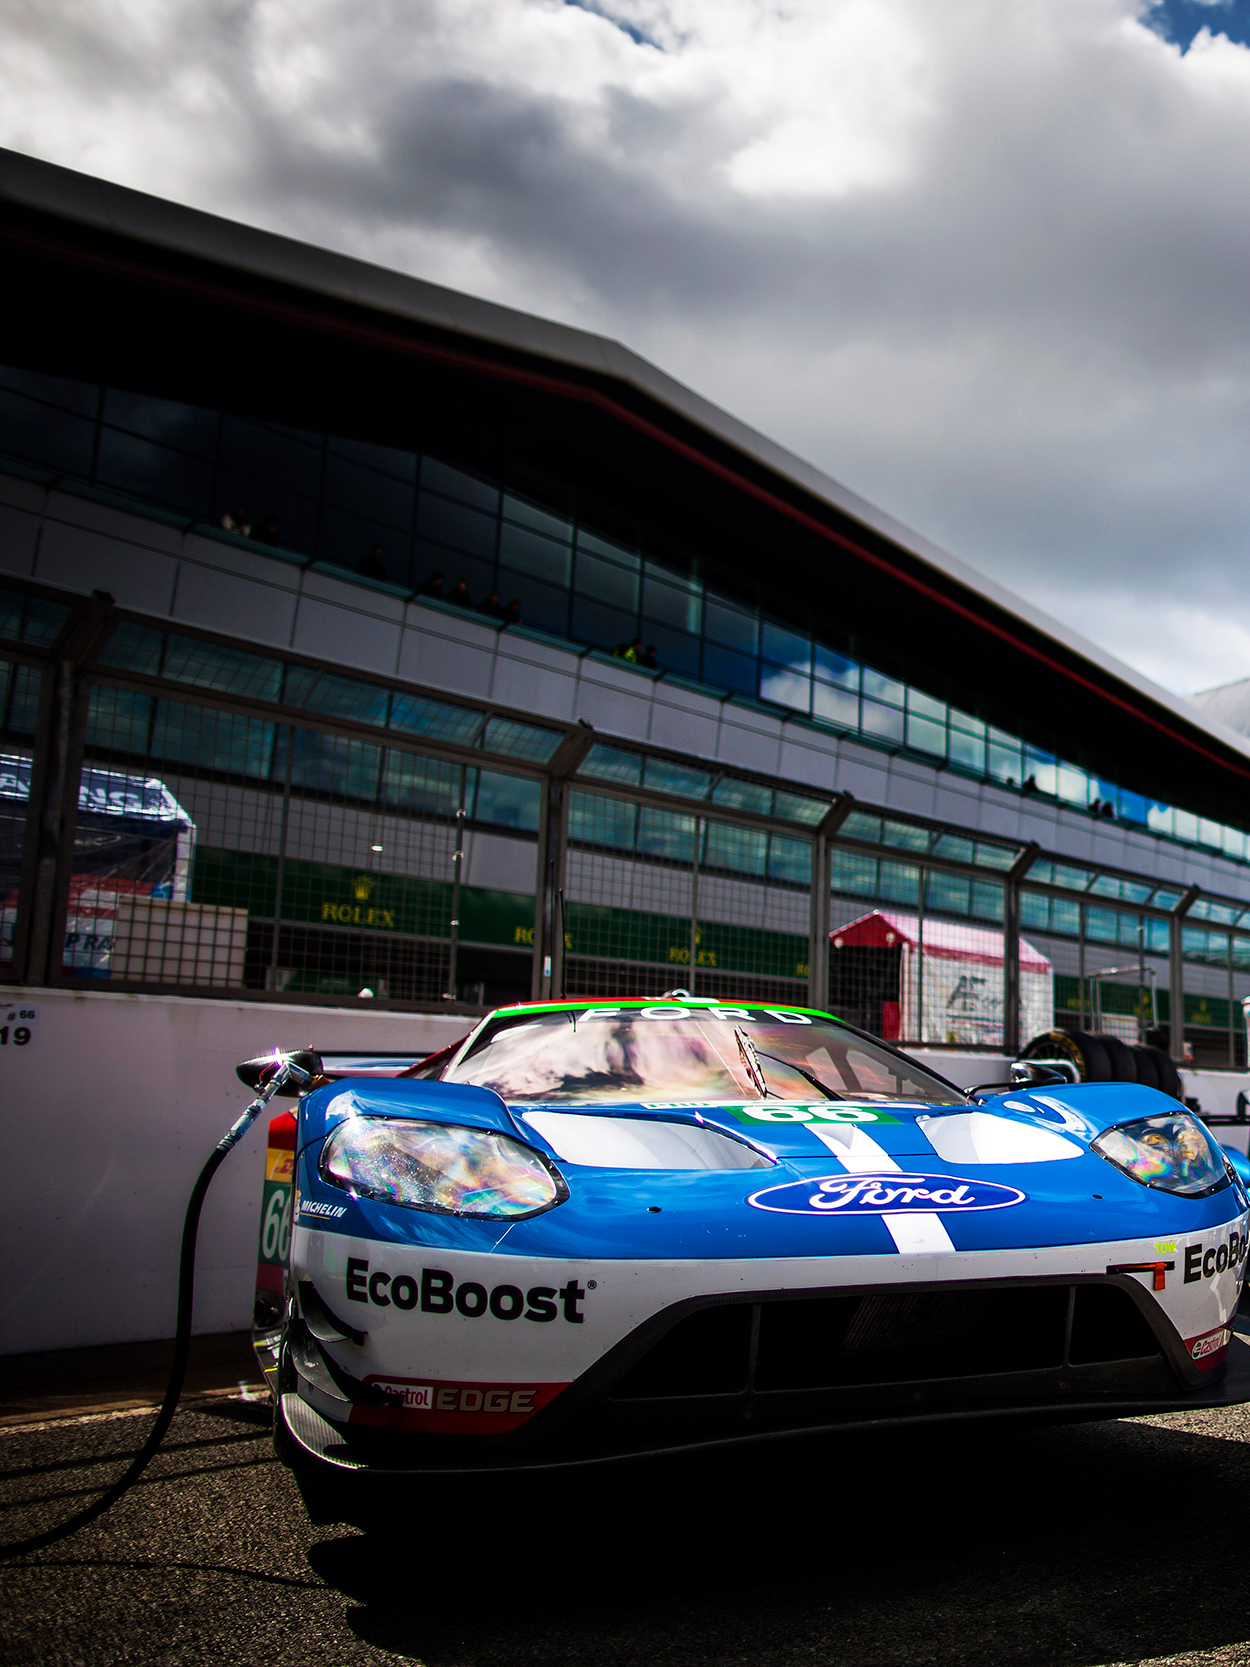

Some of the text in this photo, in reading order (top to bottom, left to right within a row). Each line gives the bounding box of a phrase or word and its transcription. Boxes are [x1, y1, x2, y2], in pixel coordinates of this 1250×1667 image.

[321, 902, 395, 928] ROLEX
[514, 926, 573, 949] ROX
[669, 946, 717, 967] ROEX
[19, 1010, 35, 1019] 66
[578, 1006, 812, 1024] FORD
[742, 1105, 879, 1123] 66
[809, 1177, 975, 1209] Ford
[301, 1200, 347, 1218] MICHELIN
[262, 1189, 291, 1262] 66
[1154, 1241, 1177, 1254] TOW
[1184, 1231, 1249, 1285] EcoBo
[436, 1388, 538, 1413] EDGE
